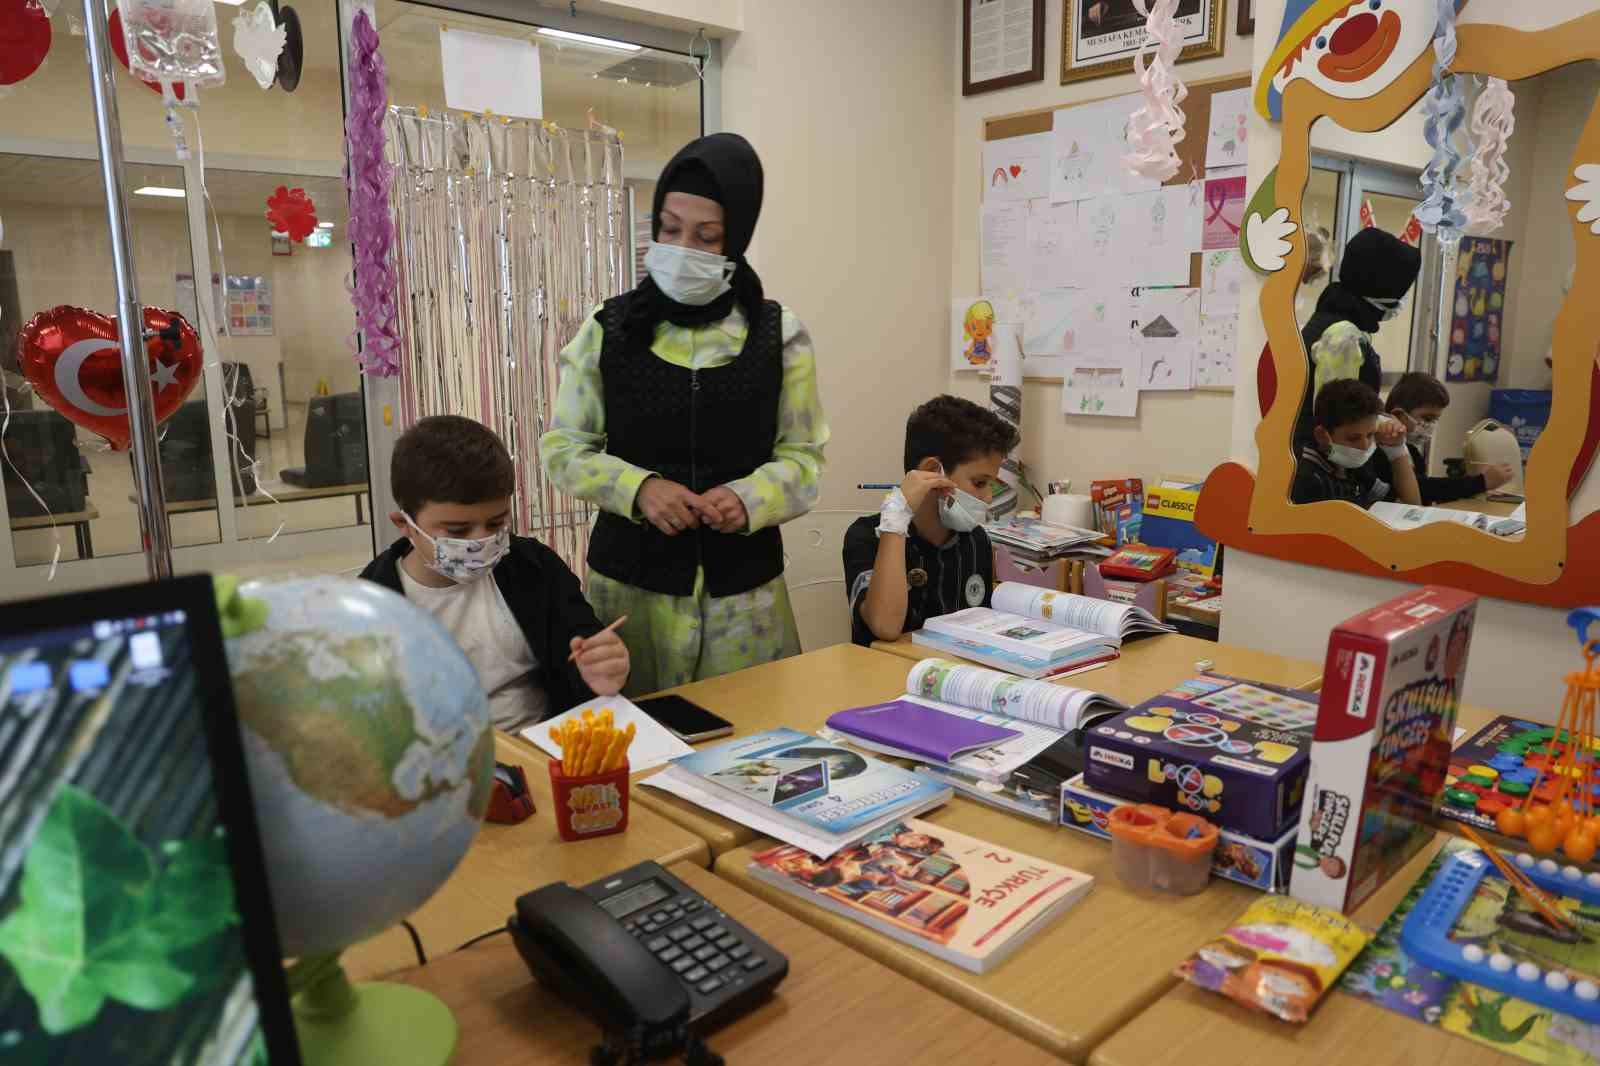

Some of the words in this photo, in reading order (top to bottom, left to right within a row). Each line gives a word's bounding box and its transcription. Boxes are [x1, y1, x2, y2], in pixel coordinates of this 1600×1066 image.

[1087, 34, 1121, 46] MUSTAFA
[1123, 26, 1150, 39] KEMA
[1161, 499, 1195, 513] CLASSIC
[1319, 795, 1350, 857] SKILLFUL
[983, 852, 1013, 864] 2
[975, 866, 1049, 908] TÜRKÇE
